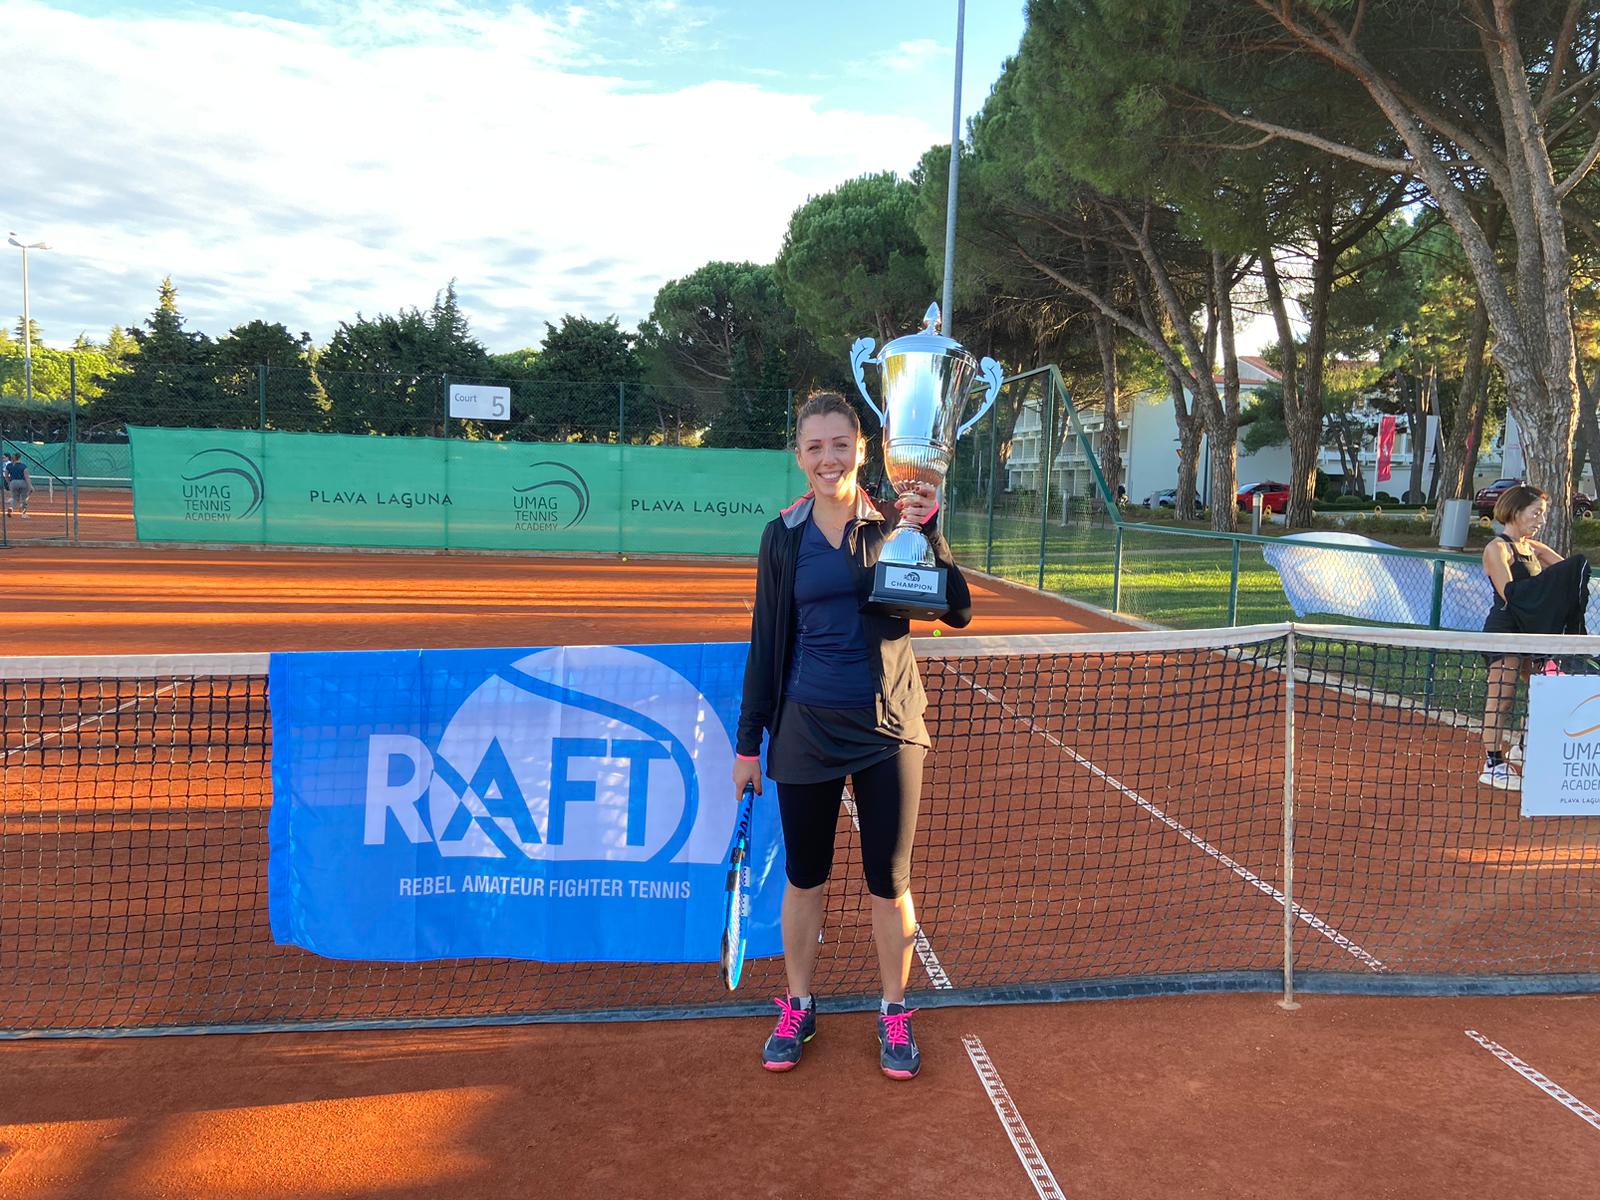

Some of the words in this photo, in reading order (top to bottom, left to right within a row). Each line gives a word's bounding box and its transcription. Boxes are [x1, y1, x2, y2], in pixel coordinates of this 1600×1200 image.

[454, 393, 477, 403] Court
[491, 395, 505, 417] 5
[182, 485, 230, 499] UMAG
[310, 490, 368, 505] PLAVA
[377, 492, 453, 508] LAGUNA
[185, 499, 231, 512] TENNIS
[513, 496, 558, 510] UMAG
[631, 499, 685, 512] PLAVA
[693, 501, 765, 516] LAGUNA
[184, 512, 231, 522] ACADEMY
[515, 510, 558, 522] TENNIS
[514, 522, 558, 531] ACADEMY
[891, 581, 932, 591] CHAMPION
[363, 734, 673, 847] RAFT
[1561, 779, 1600, 791] ACADE
[399, 876, 455, 896] REBEL
[461, 876, 545, 897] AMATEUR
[548, 879, 623, 899] FIGHTER
[628, 879, 692, 900] TENNIS
